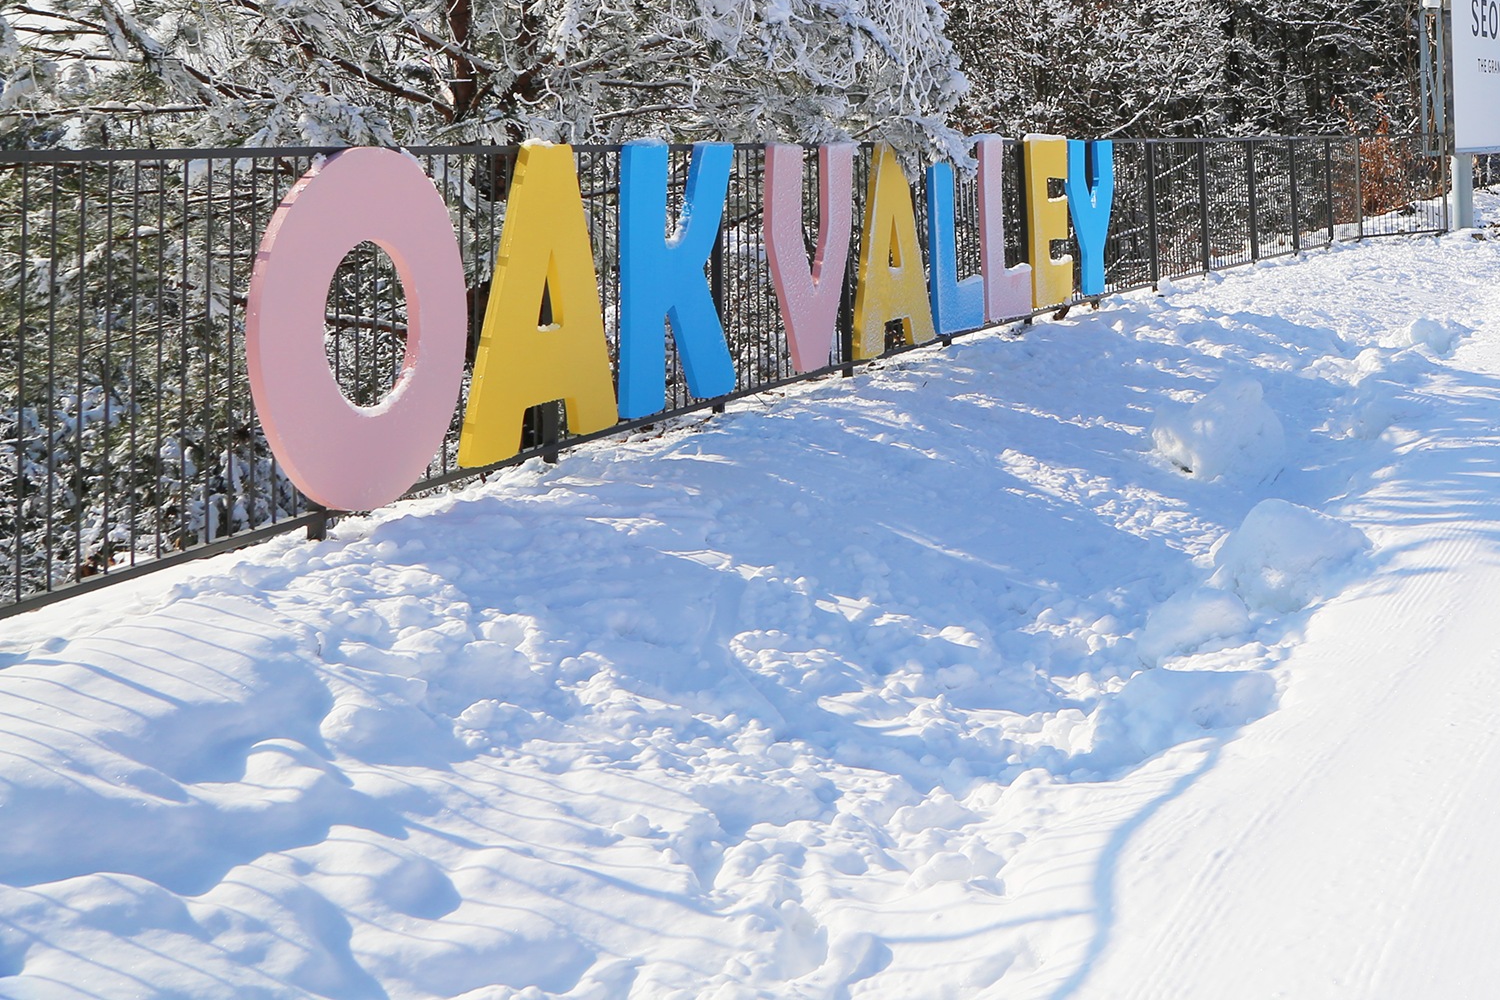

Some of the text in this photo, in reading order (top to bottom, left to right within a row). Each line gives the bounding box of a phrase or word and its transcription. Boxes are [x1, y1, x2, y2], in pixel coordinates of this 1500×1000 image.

[1478, 58, 1487, 73] THE
[247, 133, 1114, 512] OAK VALLEY
